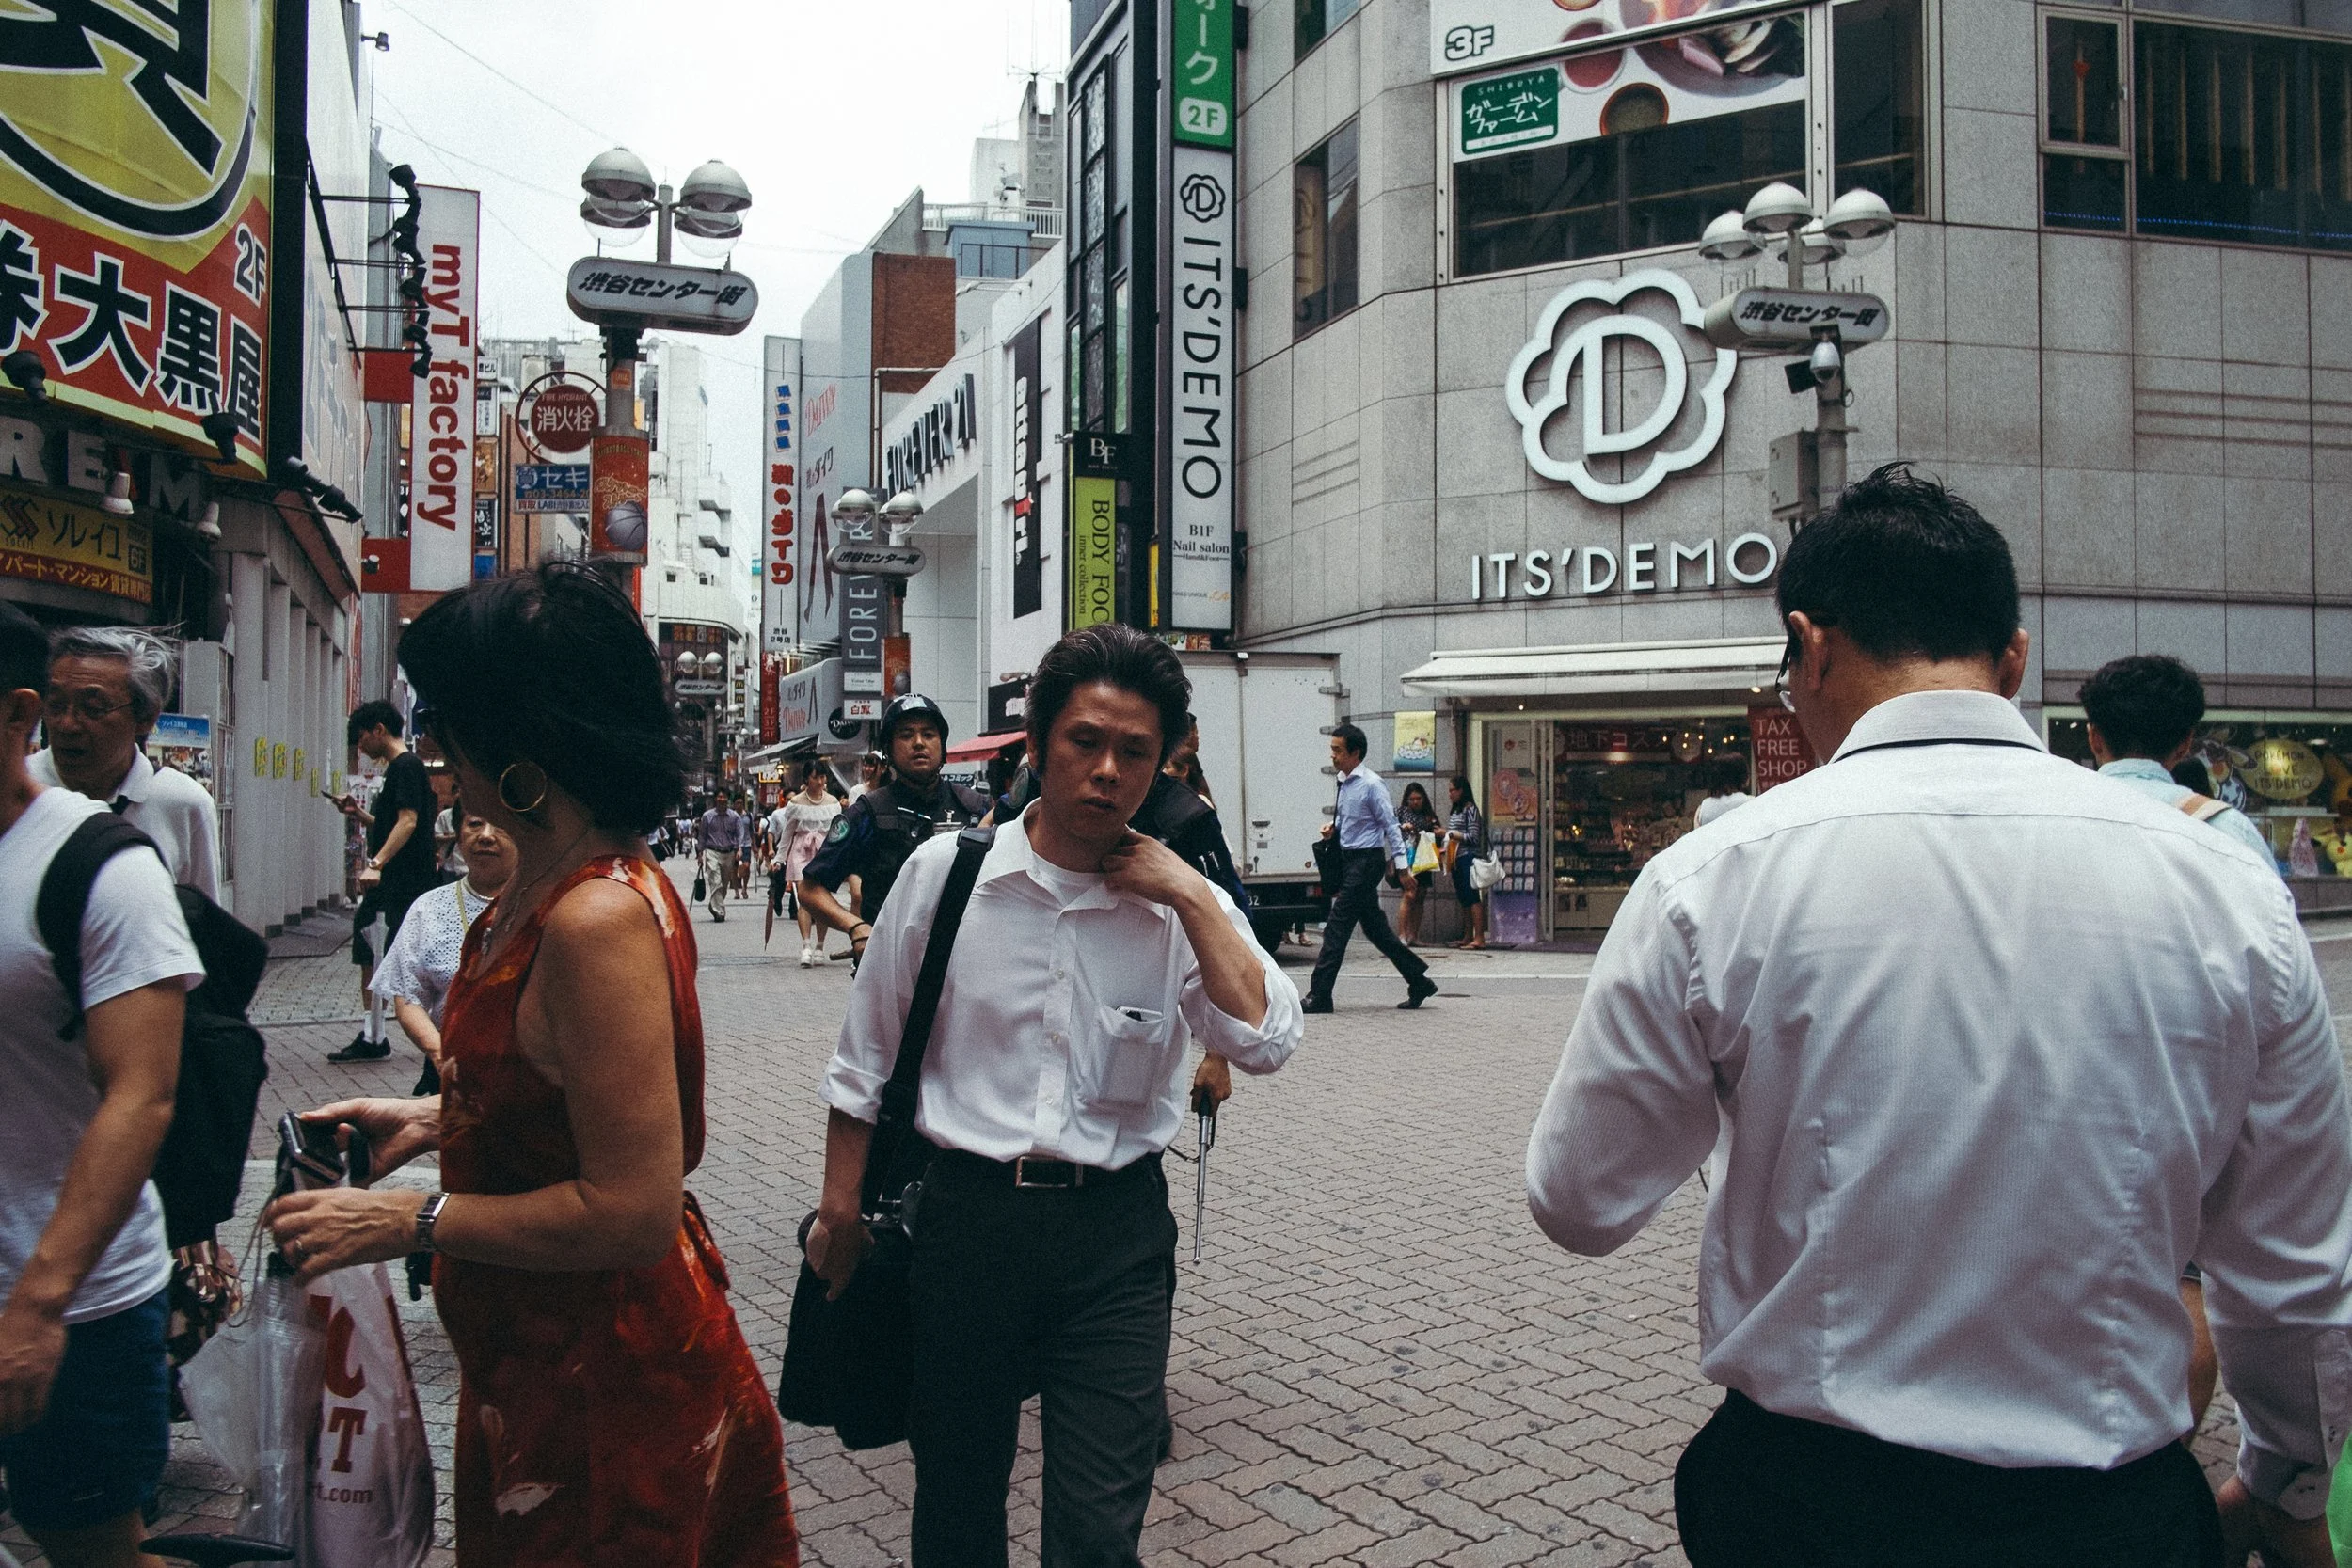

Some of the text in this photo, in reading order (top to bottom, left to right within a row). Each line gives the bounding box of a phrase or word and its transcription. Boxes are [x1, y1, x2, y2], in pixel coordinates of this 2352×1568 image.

[1185, 0, 1219, 85] ーク
[1444, 24, 1495, 61] 3F
[1478, 75, 1545, 96] SHIBUYA
[1187, 104, 1219, 129] 2F
[1466, 92, 1553, 119] ガーデン
[1470, 110, 1539, 134] ファーム
[234, 222, 266, 308] 2F
[578, 272, 749, 306] 渋谷センター街
[1740, 300, 1881, 327] 渋谷センター街
[1182, 236, 1222, 499] ITS'DEMO
[416, 244, 469, 531] myT factory
[537, 405, 595, 432] 消火栓
[1090, 437, 1117, 464] BF
[1092, 499, 1110, 564] BODY
[1173, 540, 1230, 555] Nail salon
[1079, 535, 1089, 614] inner collection
[1471, 532, 1778, 600] ITS'DEMO
[1756, 719, 1791, 736] TAX
[1757, 739, 1800, 756] FREE
[1758, 760, 1807, 777] SHOP
